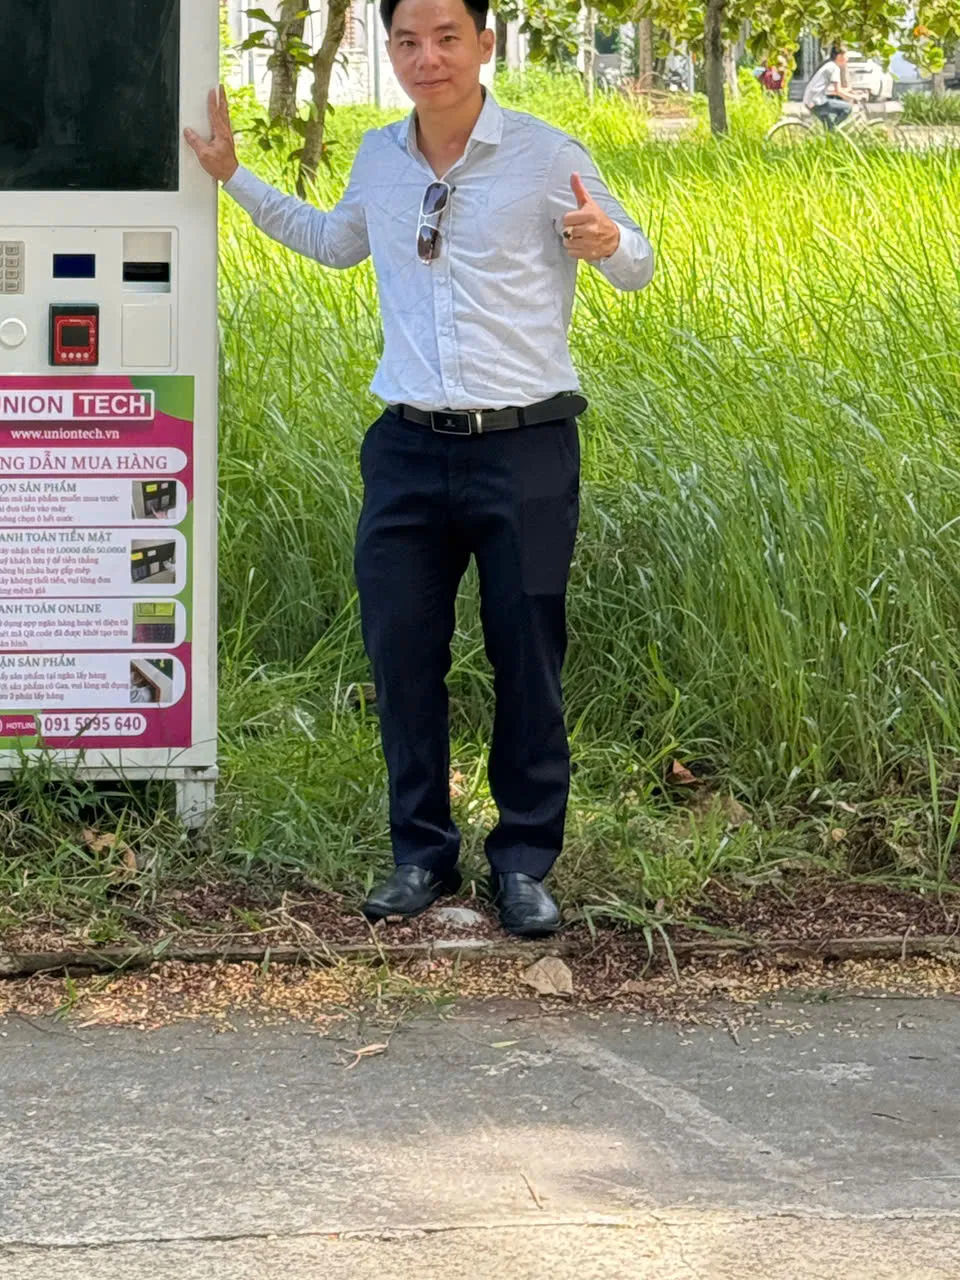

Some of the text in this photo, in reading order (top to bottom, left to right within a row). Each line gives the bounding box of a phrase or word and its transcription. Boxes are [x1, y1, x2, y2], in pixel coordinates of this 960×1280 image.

[79, 396, 145, 414] TECH
[11, 428, 120, 439] www.uniontech.vn
[30, 451, 66, 470] DẪN
[73, 457, 112, 469] MUA
[117, 454, 167, 469] HÀNG
[19, 481, 40, 492] SẢN
[44, 480, 76, 492] PHẨM
[26, 531, 56, 542] TOÁN
[59, 529, 84, 542] TIỀN
[88, 532, 112, 543] MẶT
[25, 602, 56, 613] TOÁN
[58, 604, 101, 613] ONLINE
[18, 656, 40, 667] SẢN
[43, 655, 76, 667] PHẨM
[45, 718, 69, 731] 091
[115, 717, 140, 730] 640
